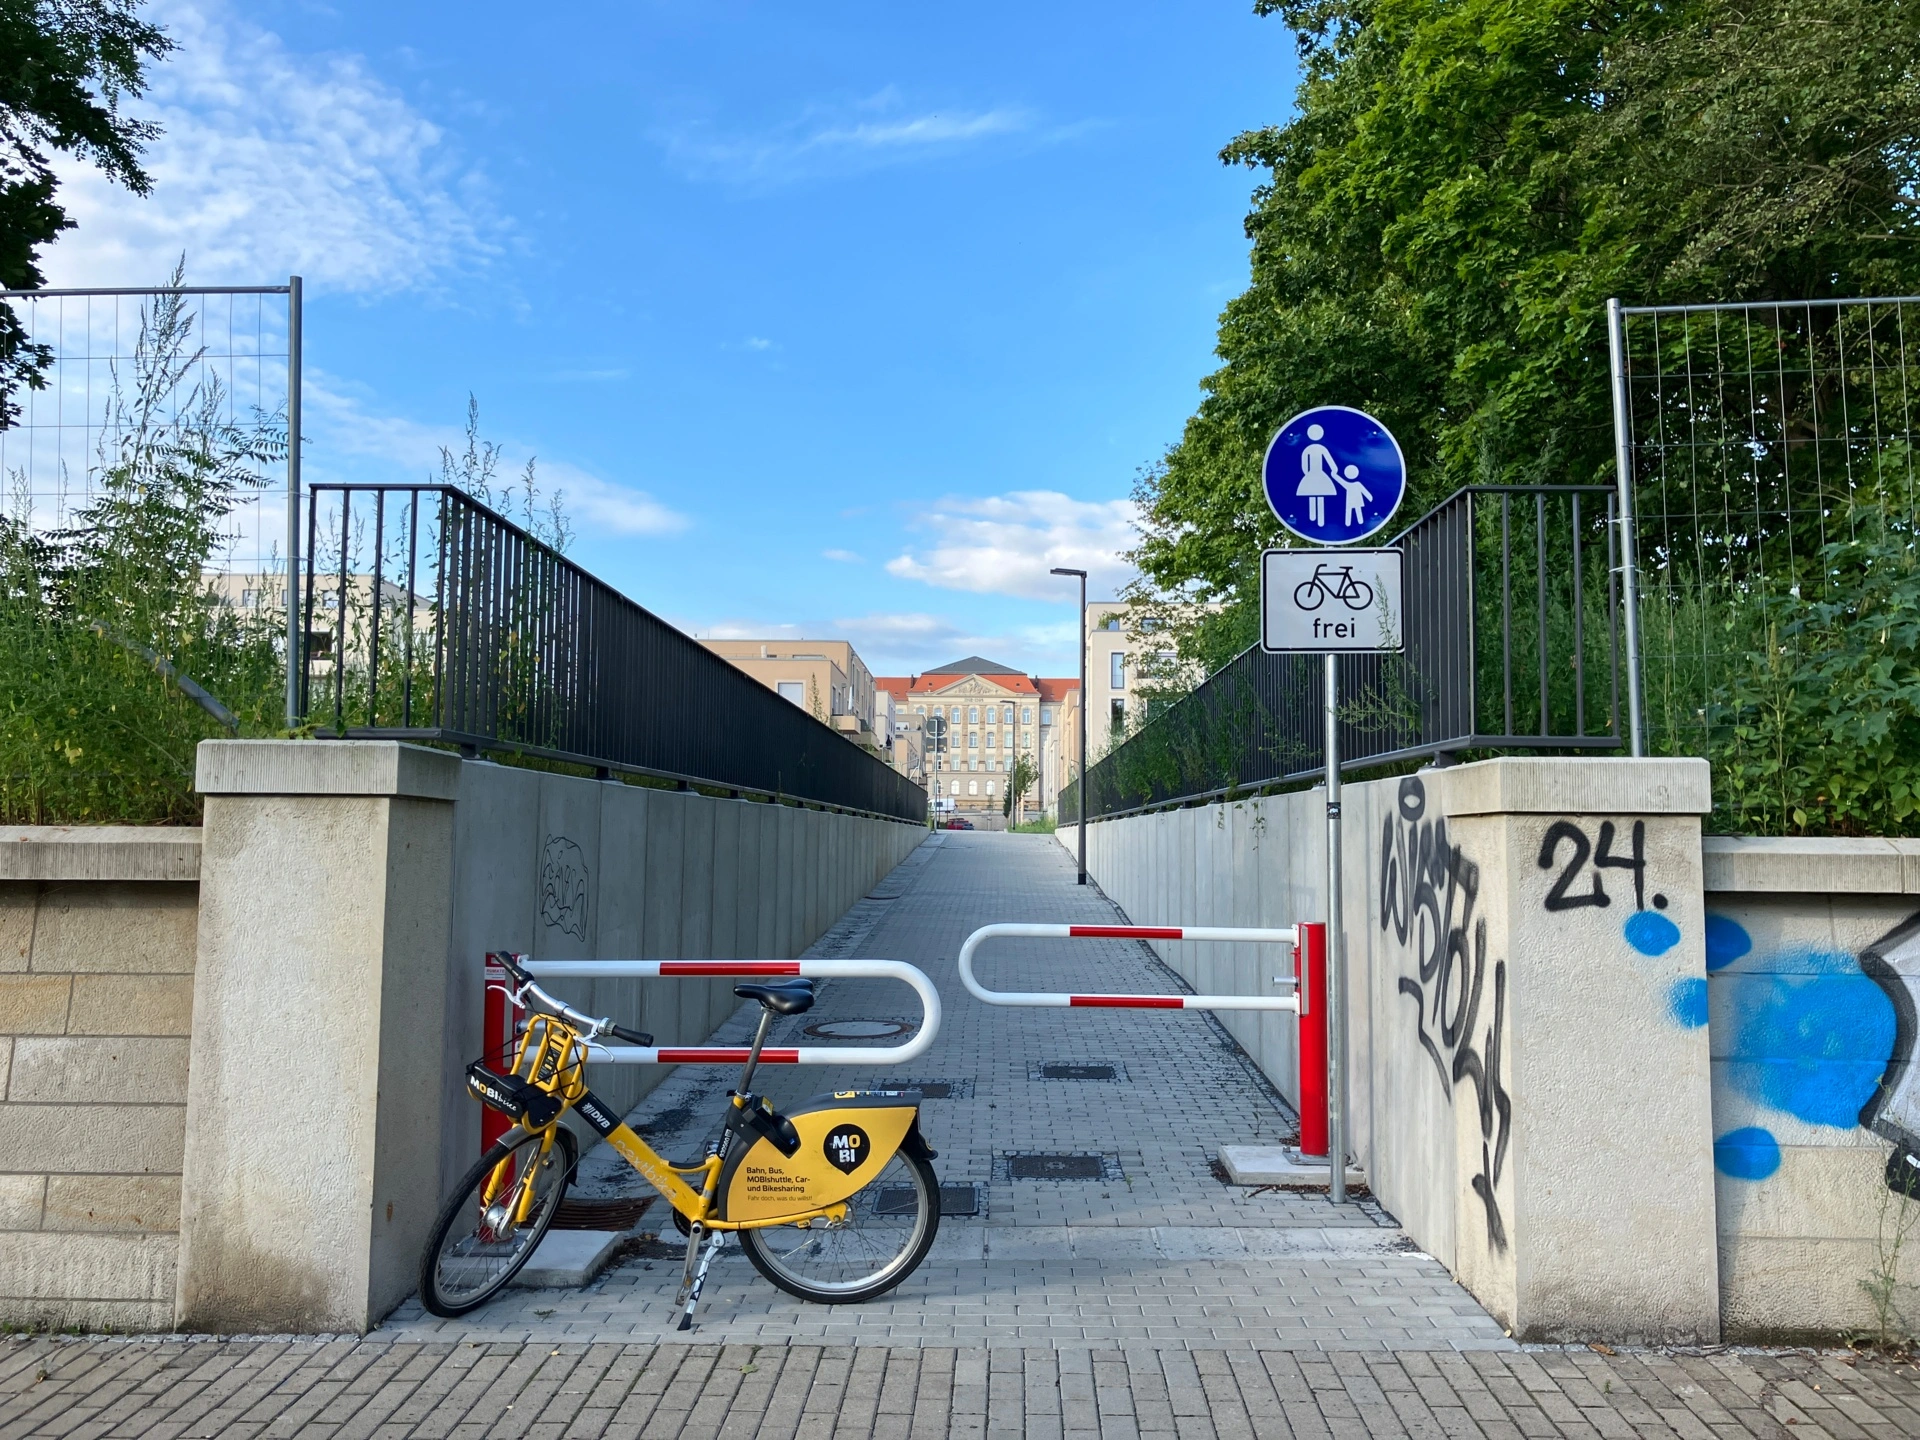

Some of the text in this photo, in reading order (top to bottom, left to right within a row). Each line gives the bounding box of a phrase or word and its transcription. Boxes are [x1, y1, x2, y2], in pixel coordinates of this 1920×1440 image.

[1312, 617, 1355, 638] frei
[590, 1110, 610, 1128] DVB
[615, 1140, 677, 1201] nextbike
[746, 1167, 784, 1175] Bahn, Bus,
[762, 1185, 805, 1193] Bikesharing
